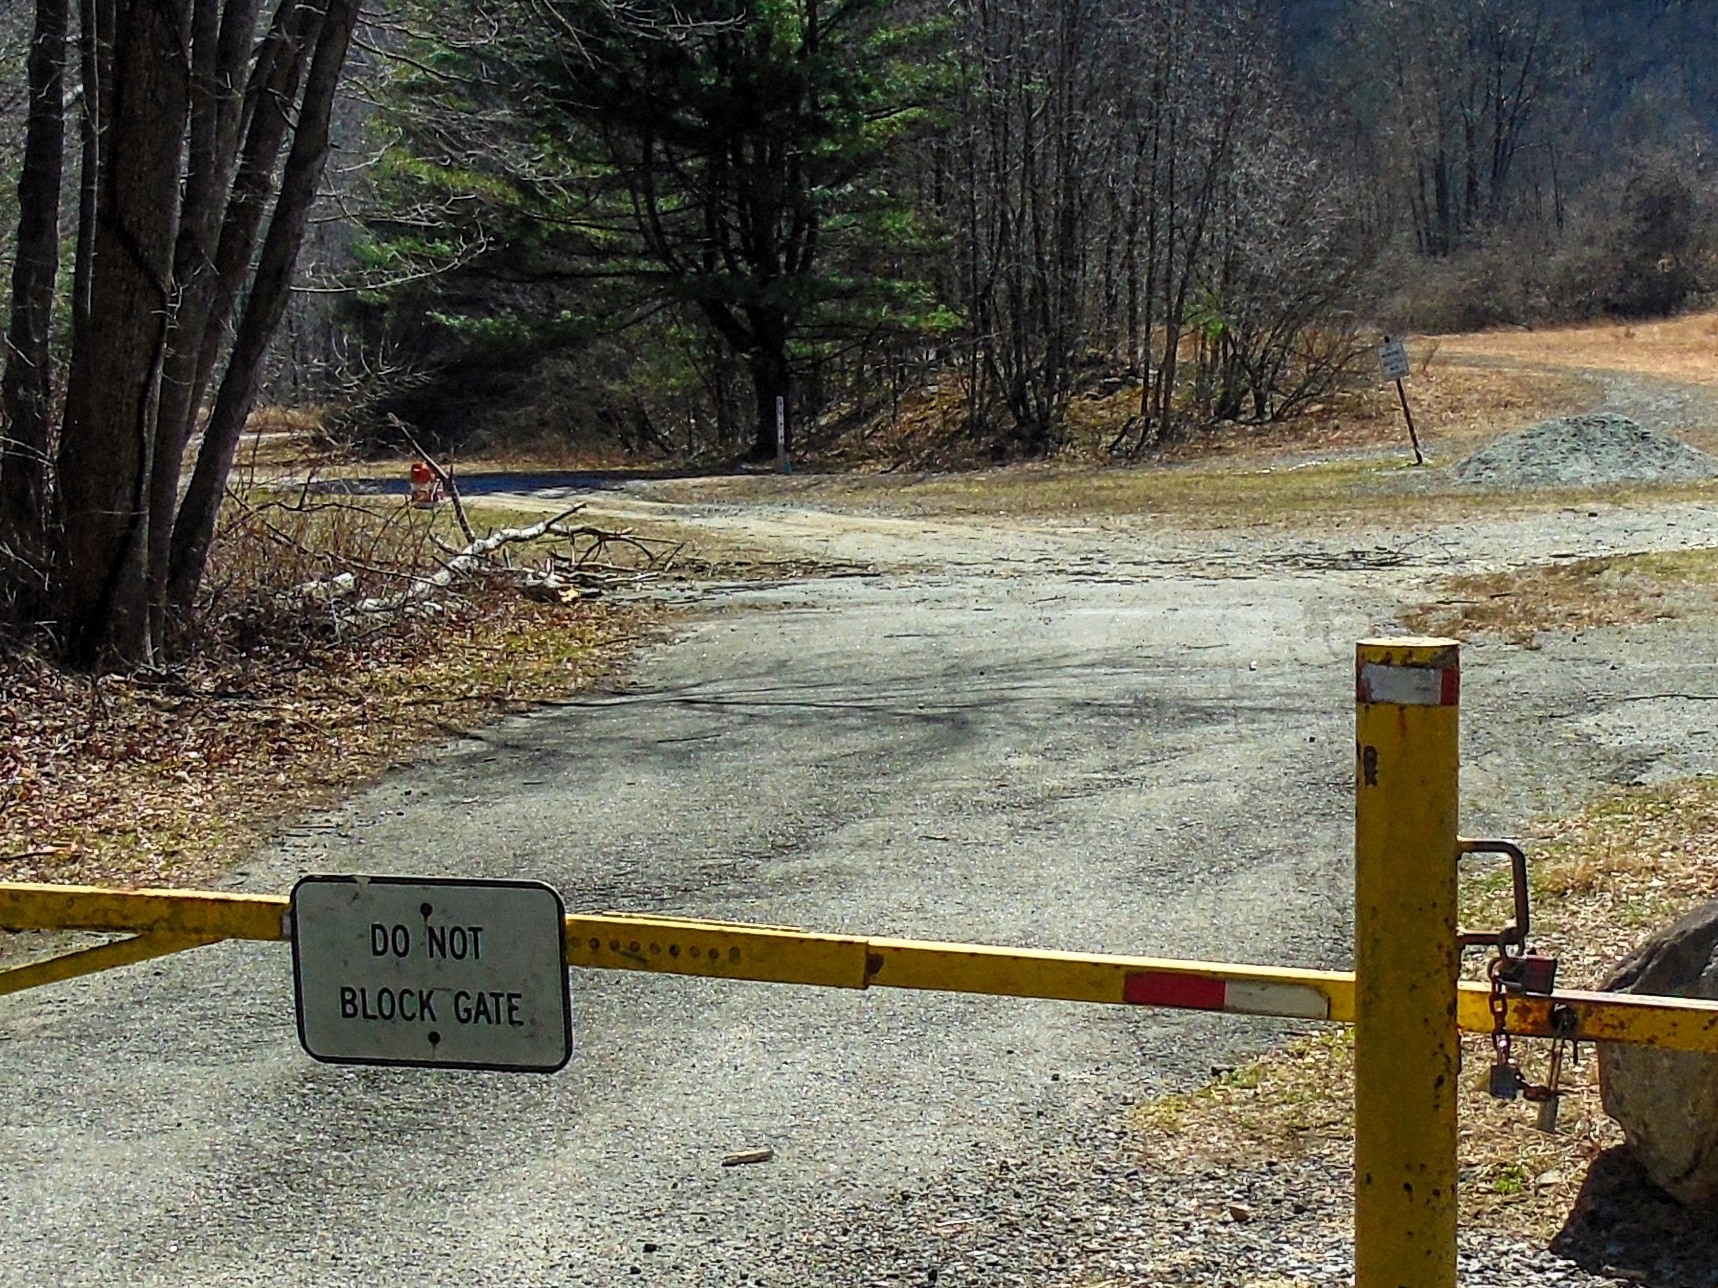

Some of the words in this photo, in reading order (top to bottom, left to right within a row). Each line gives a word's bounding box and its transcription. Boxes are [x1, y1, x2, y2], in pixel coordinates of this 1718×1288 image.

[371, 924, 410, 957] DO
[428, 926, 483, 960] NOT
[340, 986, 436, 1022] BLOCK
[454, 991, 524, 1025] GATE
